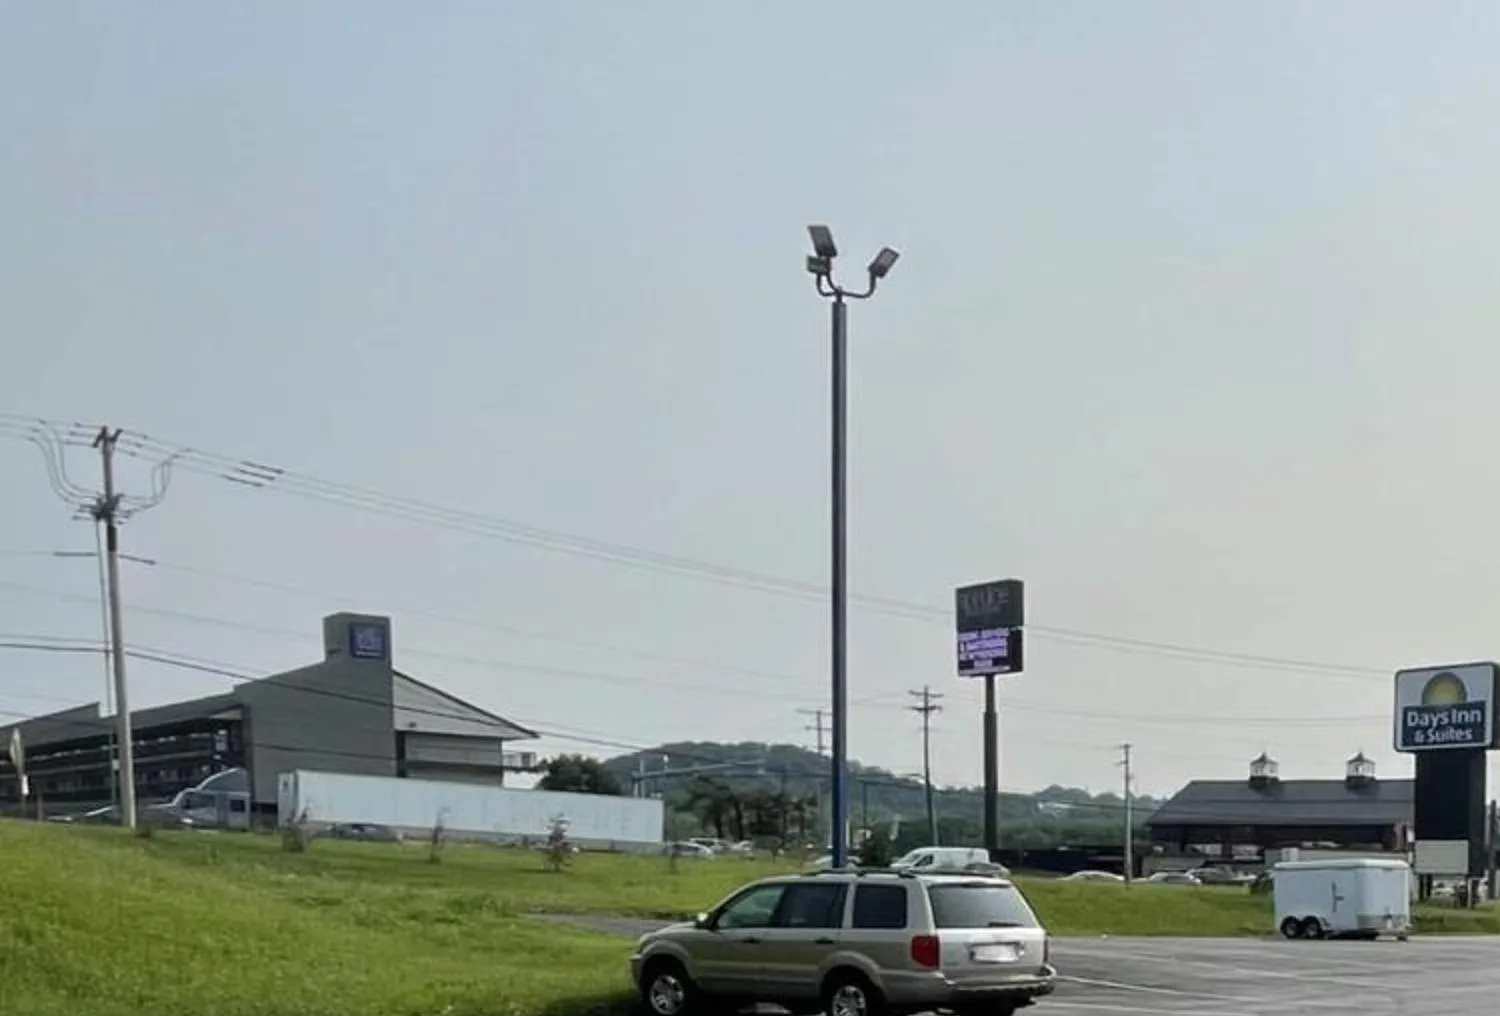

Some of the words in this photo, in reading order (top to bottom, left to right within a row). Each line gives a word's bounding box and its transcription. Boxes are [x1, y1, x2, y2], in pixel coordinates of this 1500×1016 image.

[1407, 711, 1448, 727] Days
[1452, 708, 1482, 724] Inn
[1415, 730, 1424, 743] &
[1427, 727, 1473, 743] Suites
